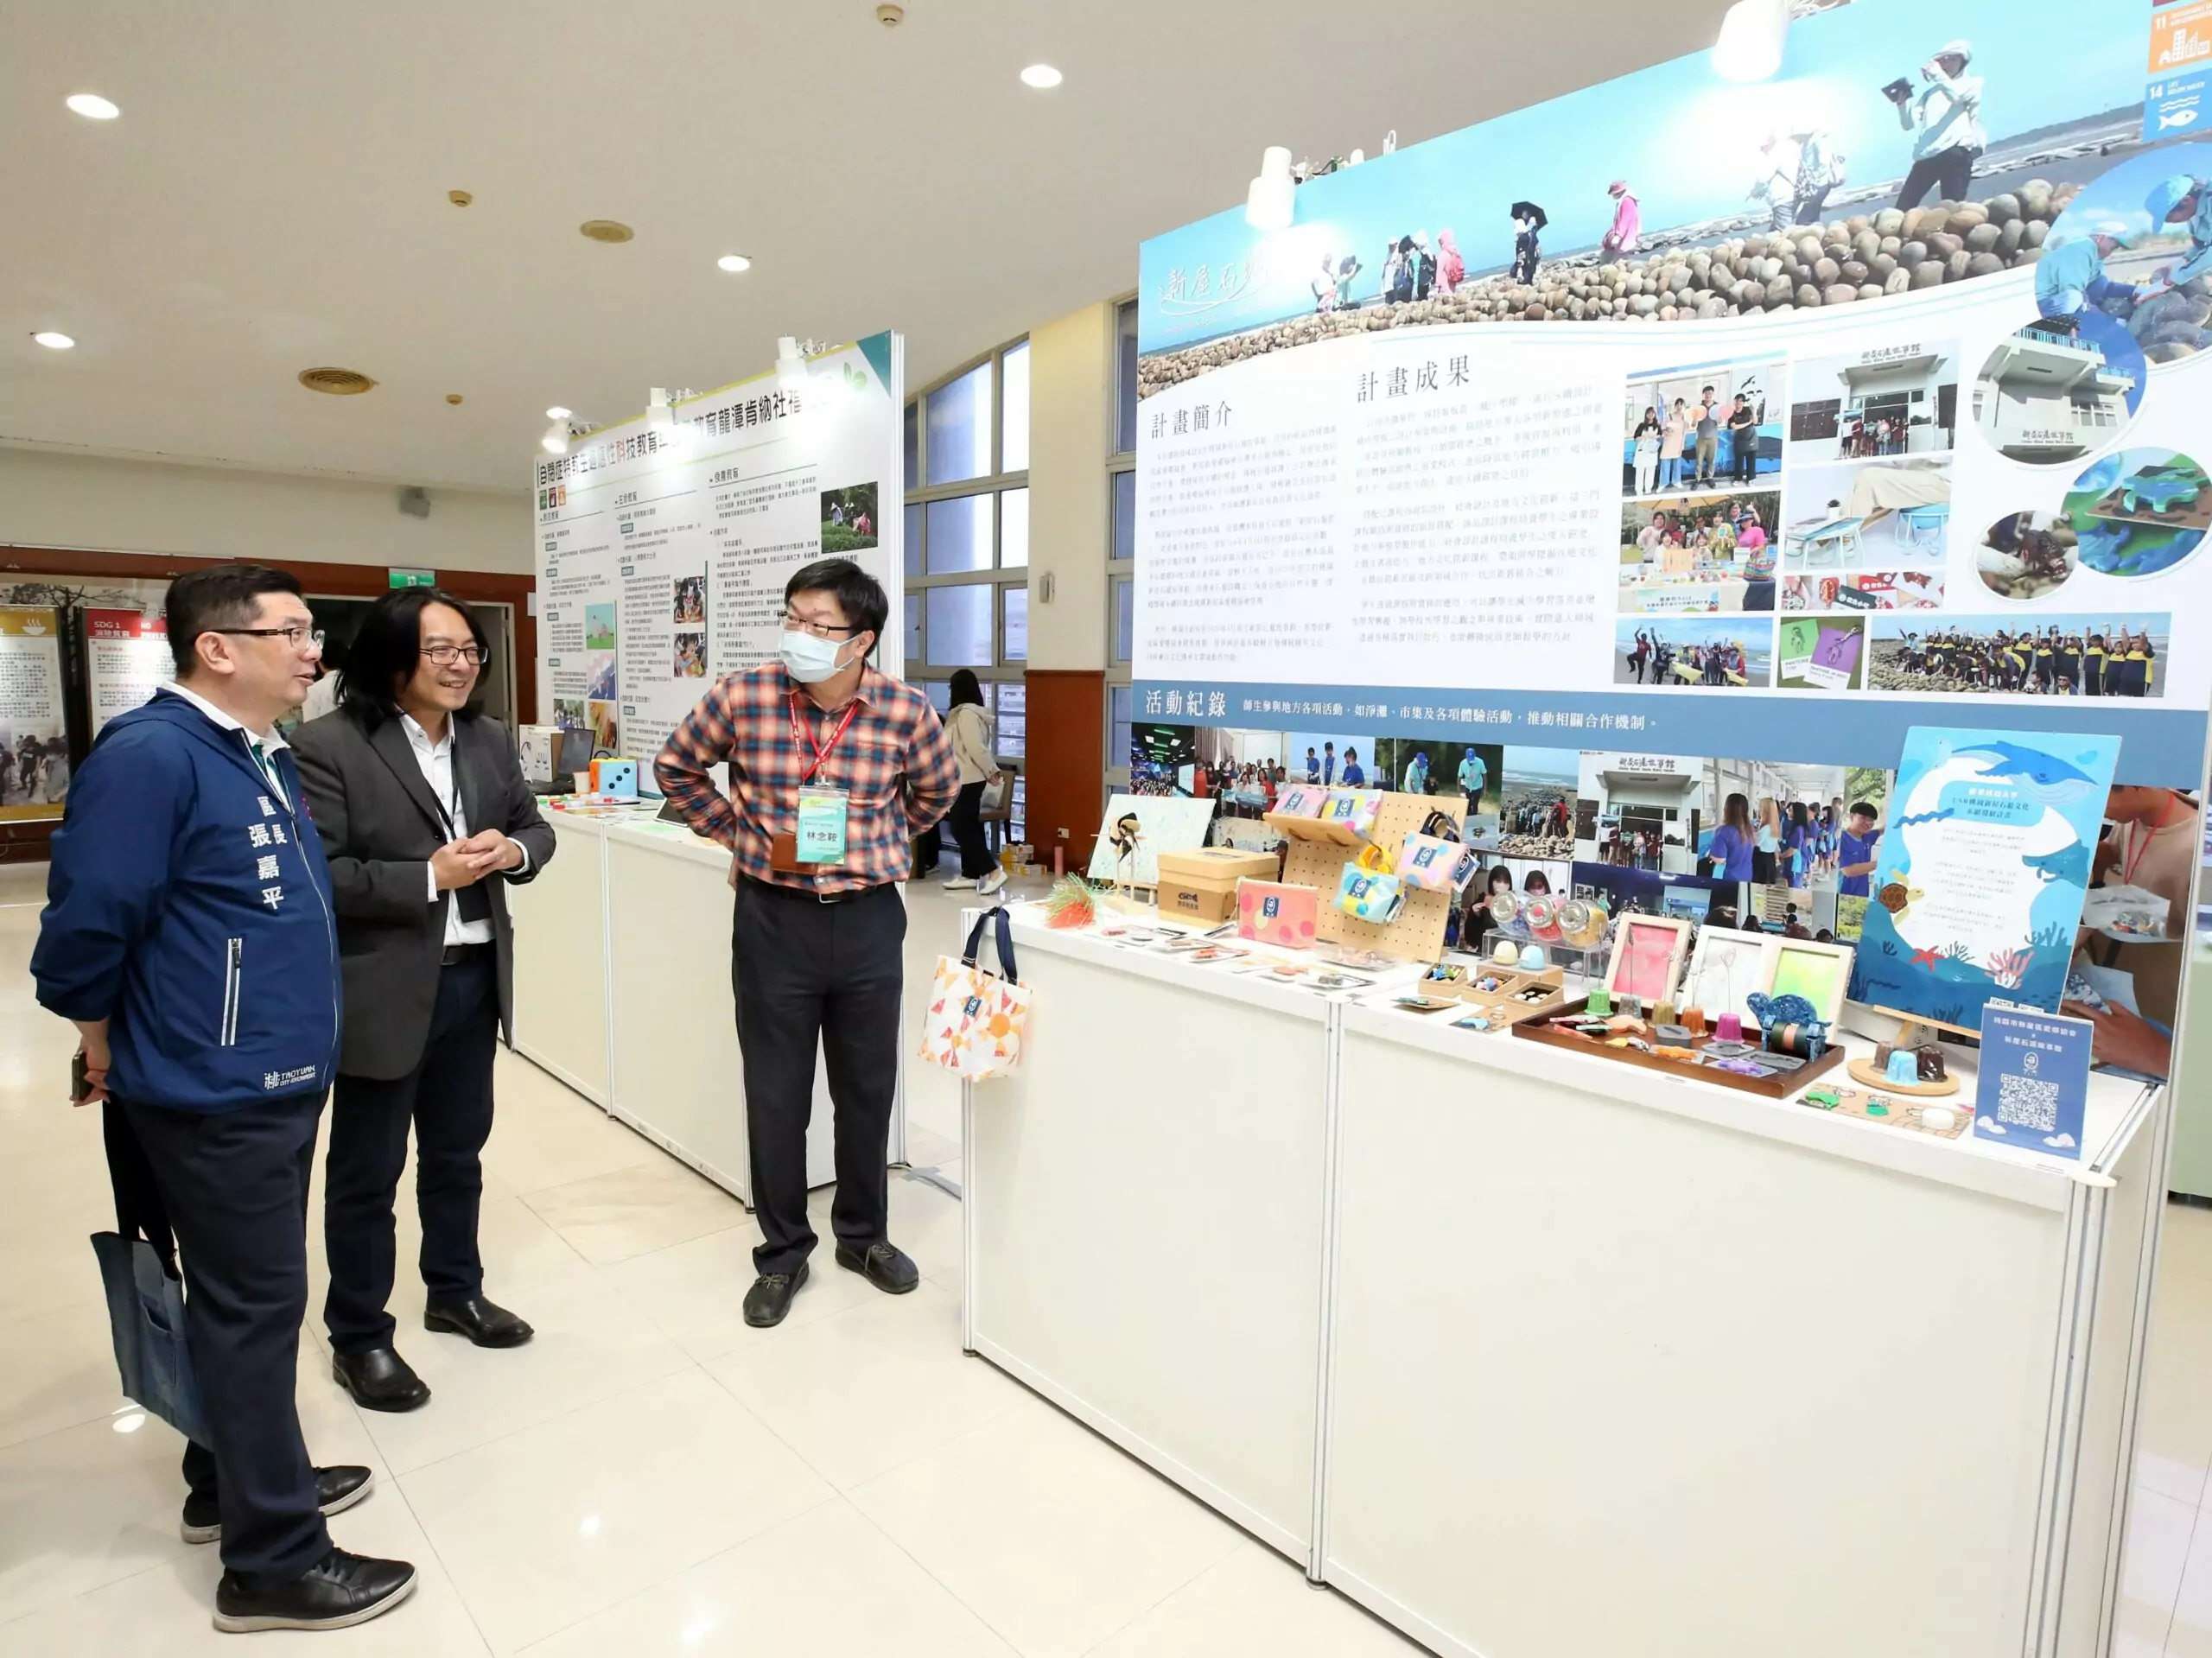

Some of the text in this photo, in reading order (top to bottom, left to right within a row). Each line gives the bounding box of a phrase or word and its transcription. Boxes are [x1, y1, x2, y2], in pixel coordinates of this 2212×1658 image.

[2150, 85, 2164, 99] 14
[1357, 354, 1471, 403] 計畫成果
[1150, 400, 1233, 440] 計畫簡介
[1146, 689, 1226, 717] 活動紀錄
[248, 823, 285, 910] 張嘉平
[281, 1064, 315, 1080] TAOYUAN
